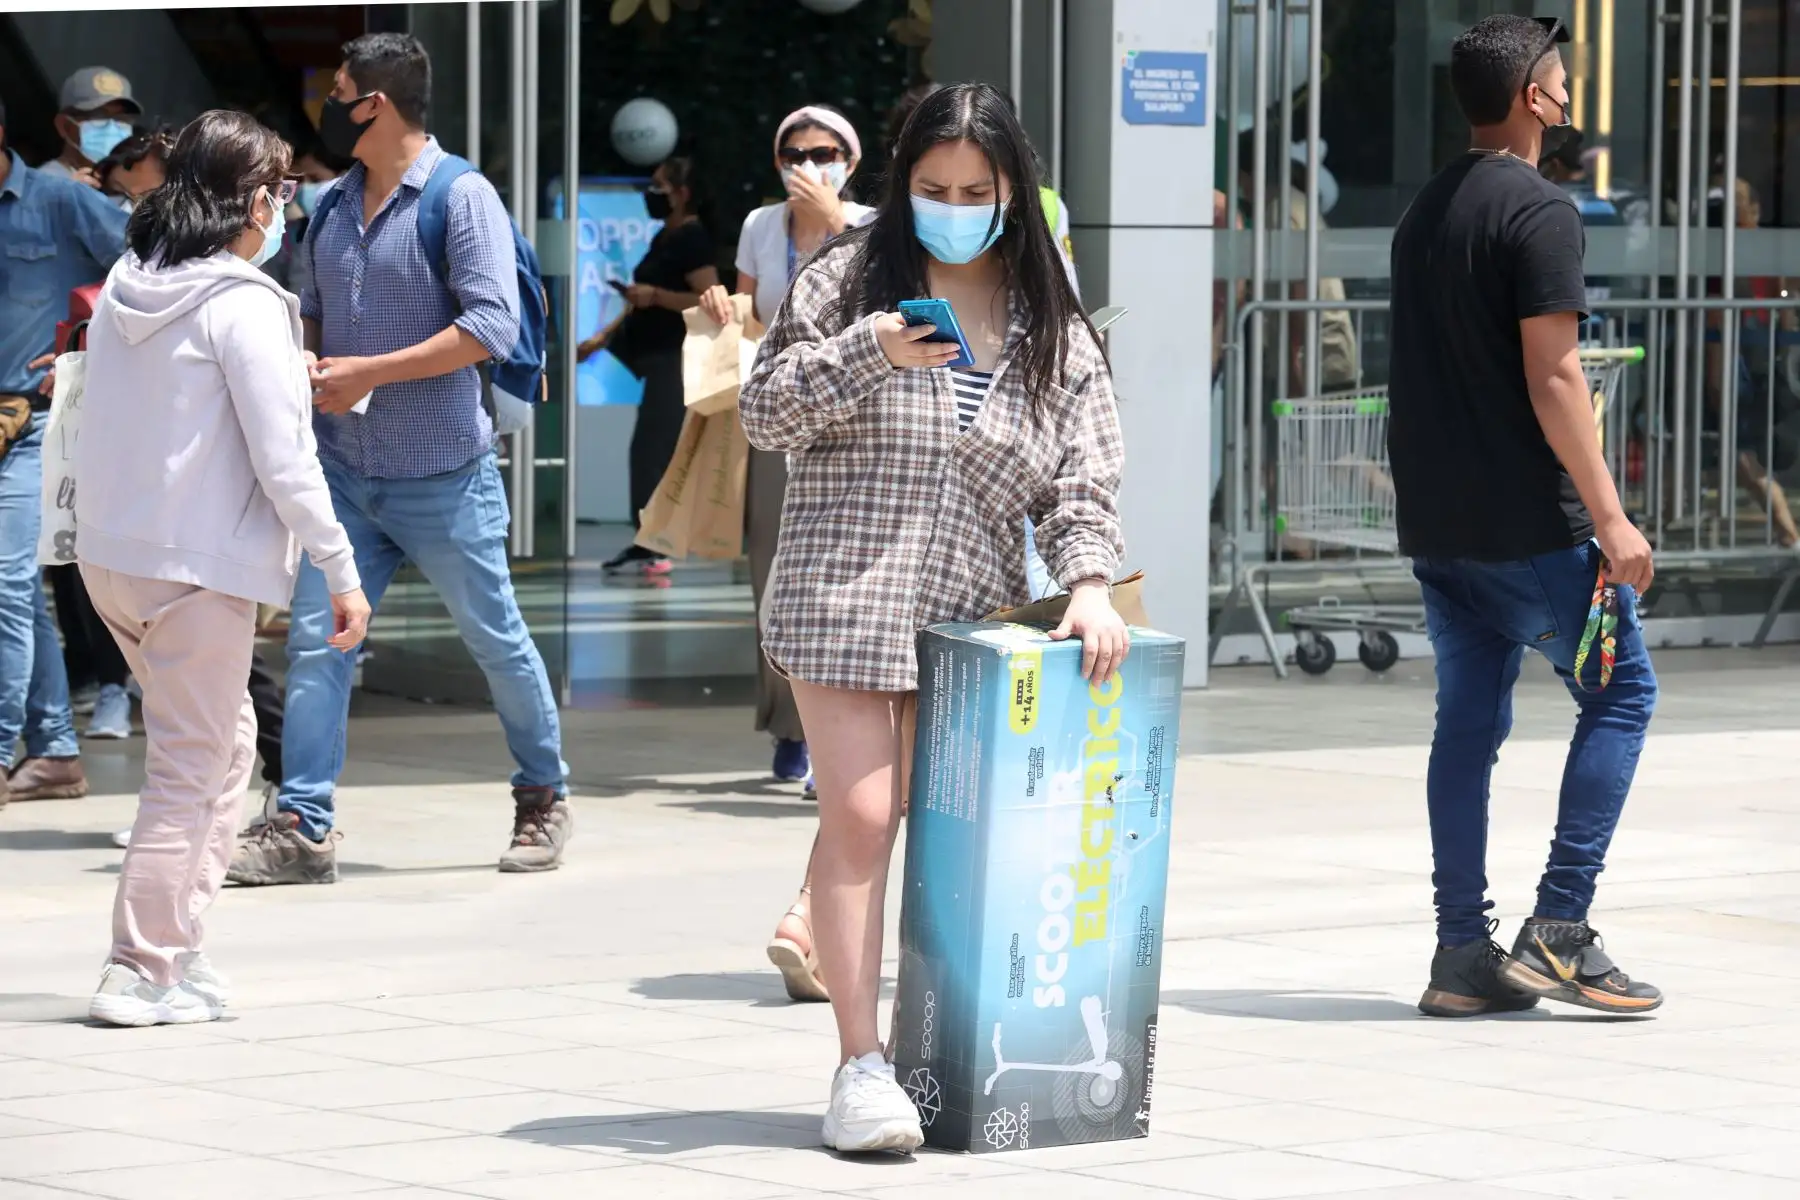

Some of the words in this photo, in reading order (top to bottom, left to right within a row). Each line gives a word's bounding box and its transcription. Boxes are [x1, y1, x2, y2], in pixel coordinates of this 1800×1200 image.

[932, 692, 938, 701] de
[930, 703, 938, 754] mantenimiento
[1036, 746, 1044, 780] variable
[1069, 669, 1124, 948] ELÉCTRICO
[1032, 766, 1081, 1009] SCOOTER
[1140, 906, 1148, 938] cargador
[1136, 938, 1148, 967] Incluye
[921, 990, 936, 1060] scoop
[1146, 1058, 1154, 1068] to
[1020, 1102, 1030, 1149] scoop
